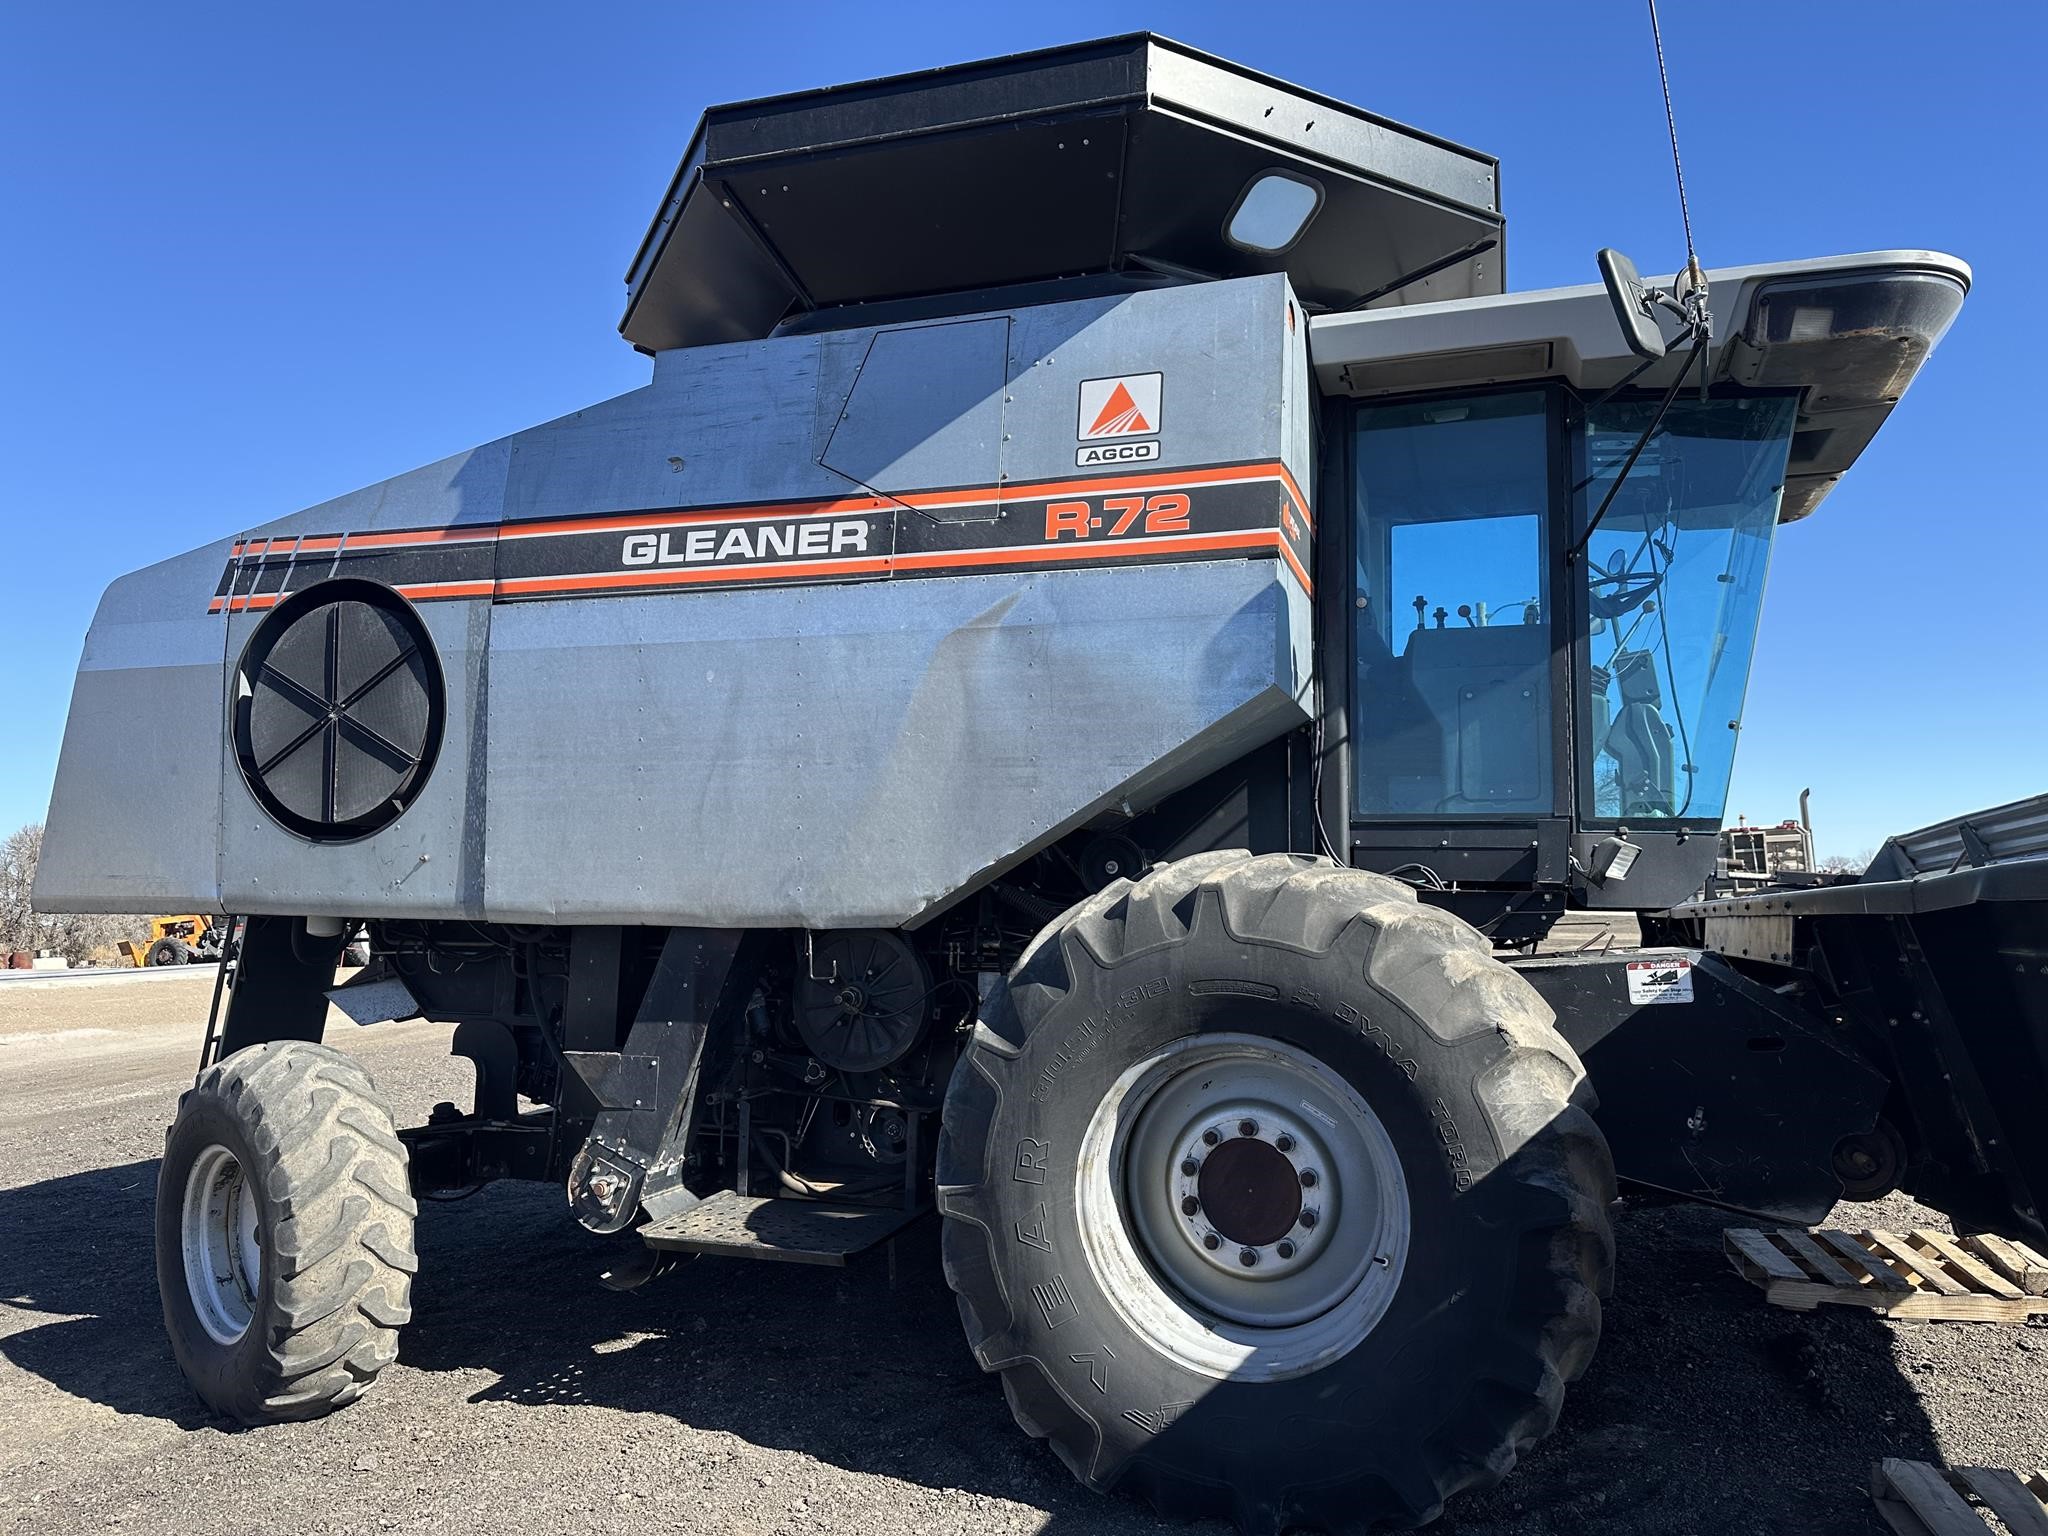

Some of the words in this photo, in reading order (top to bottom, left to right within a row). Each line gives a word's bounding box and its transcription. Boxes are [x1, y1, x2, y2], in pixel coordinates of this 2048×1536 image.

[1085, 445, 1151, 462] AGCO
[621, 519, 869, 566] GLEANER
[1333, 1001, 1420, 1082] DYNA
